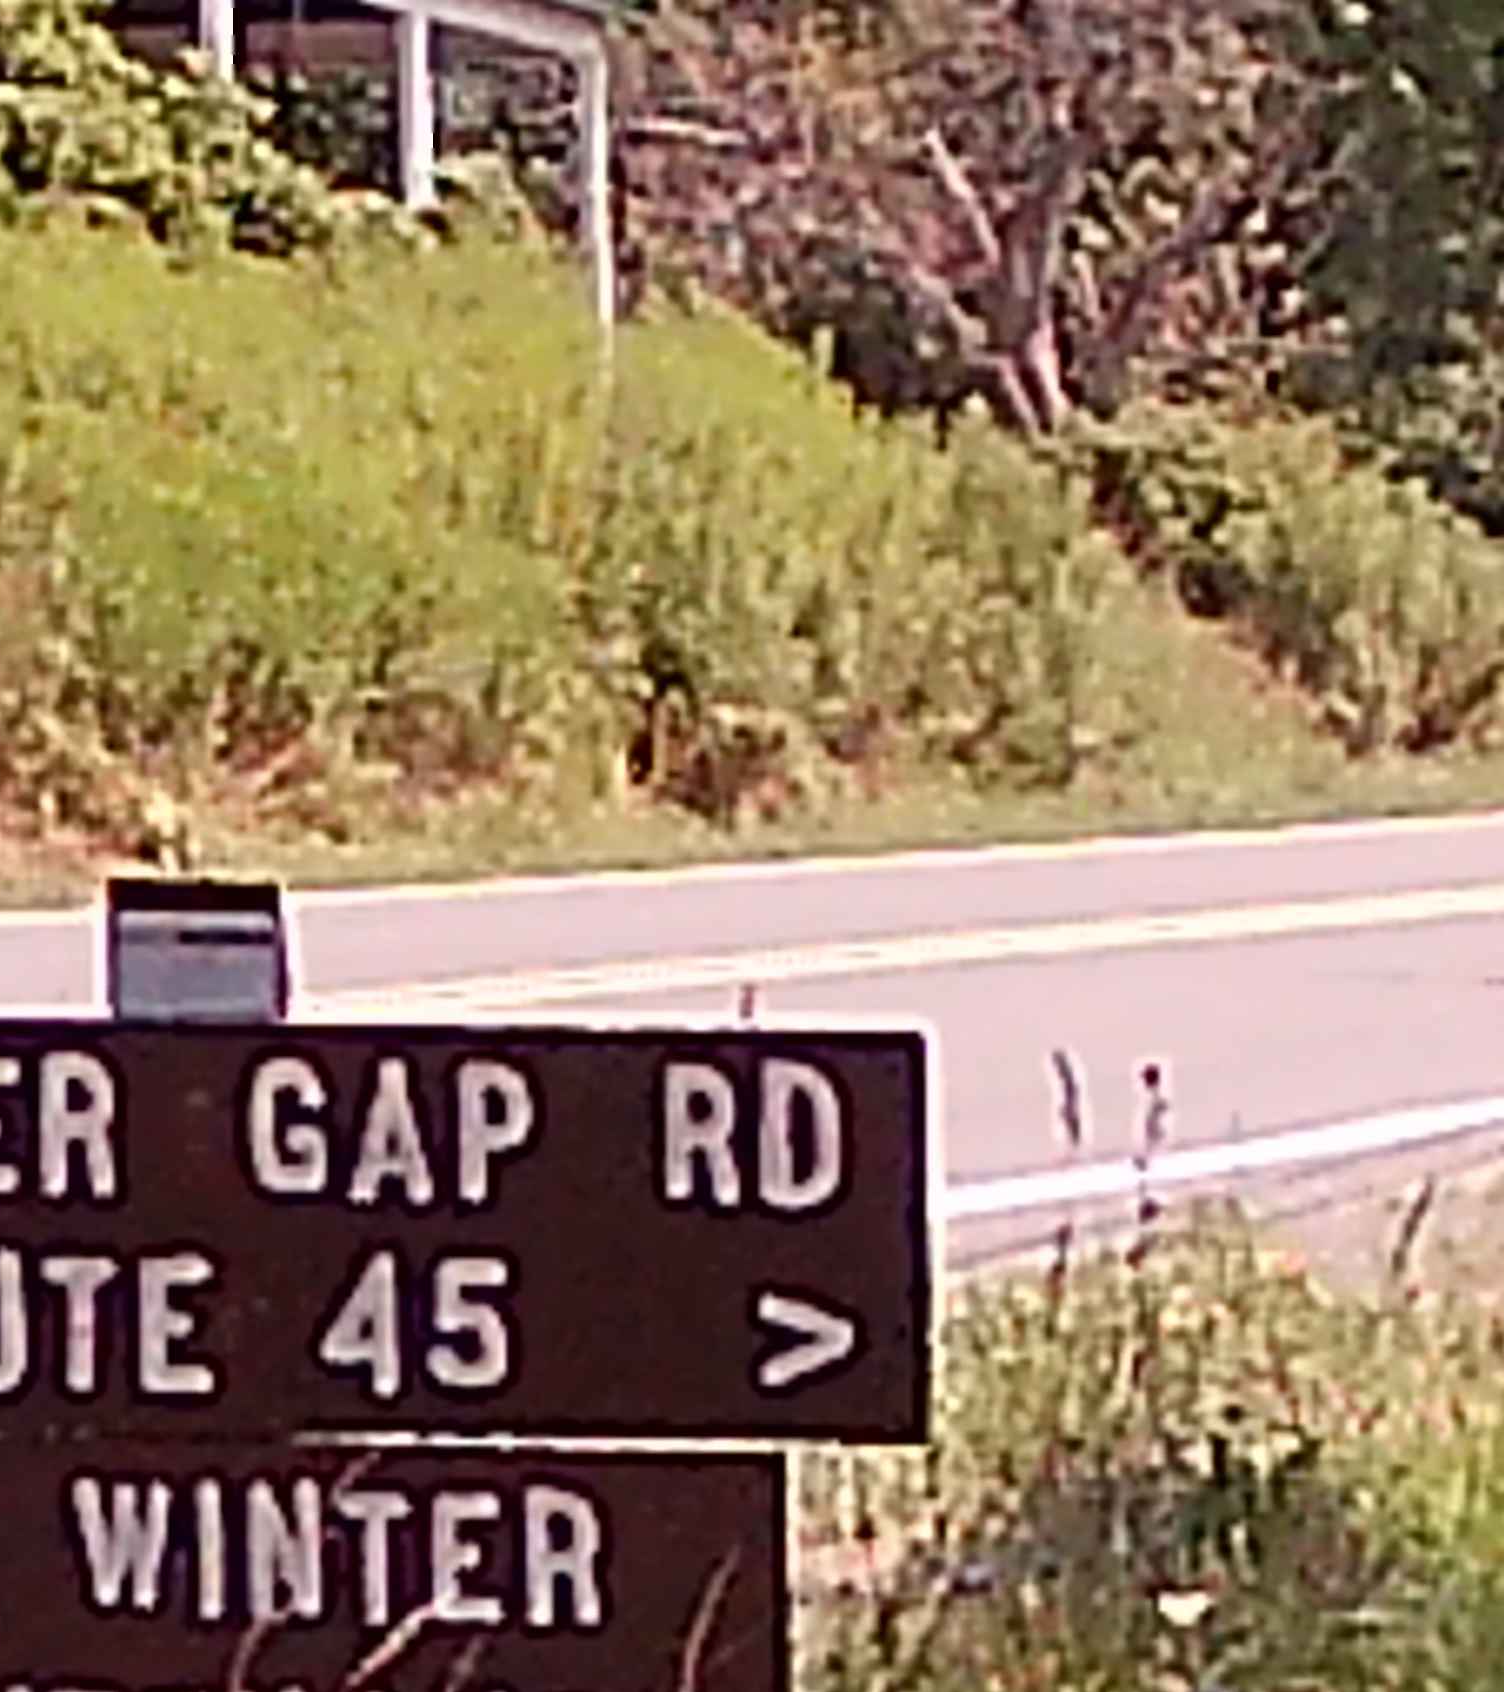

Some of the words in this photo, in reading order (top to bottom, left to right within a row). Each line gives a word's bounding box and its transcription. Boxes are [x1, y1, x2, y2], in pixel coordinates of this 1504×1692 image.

[249, 1057, 534, 1204] GAP
[664, 1060, 843, 1209] RD
[320, 1252, 508, 1394] 45
[73, 1478, 602, 1627] WINTER
